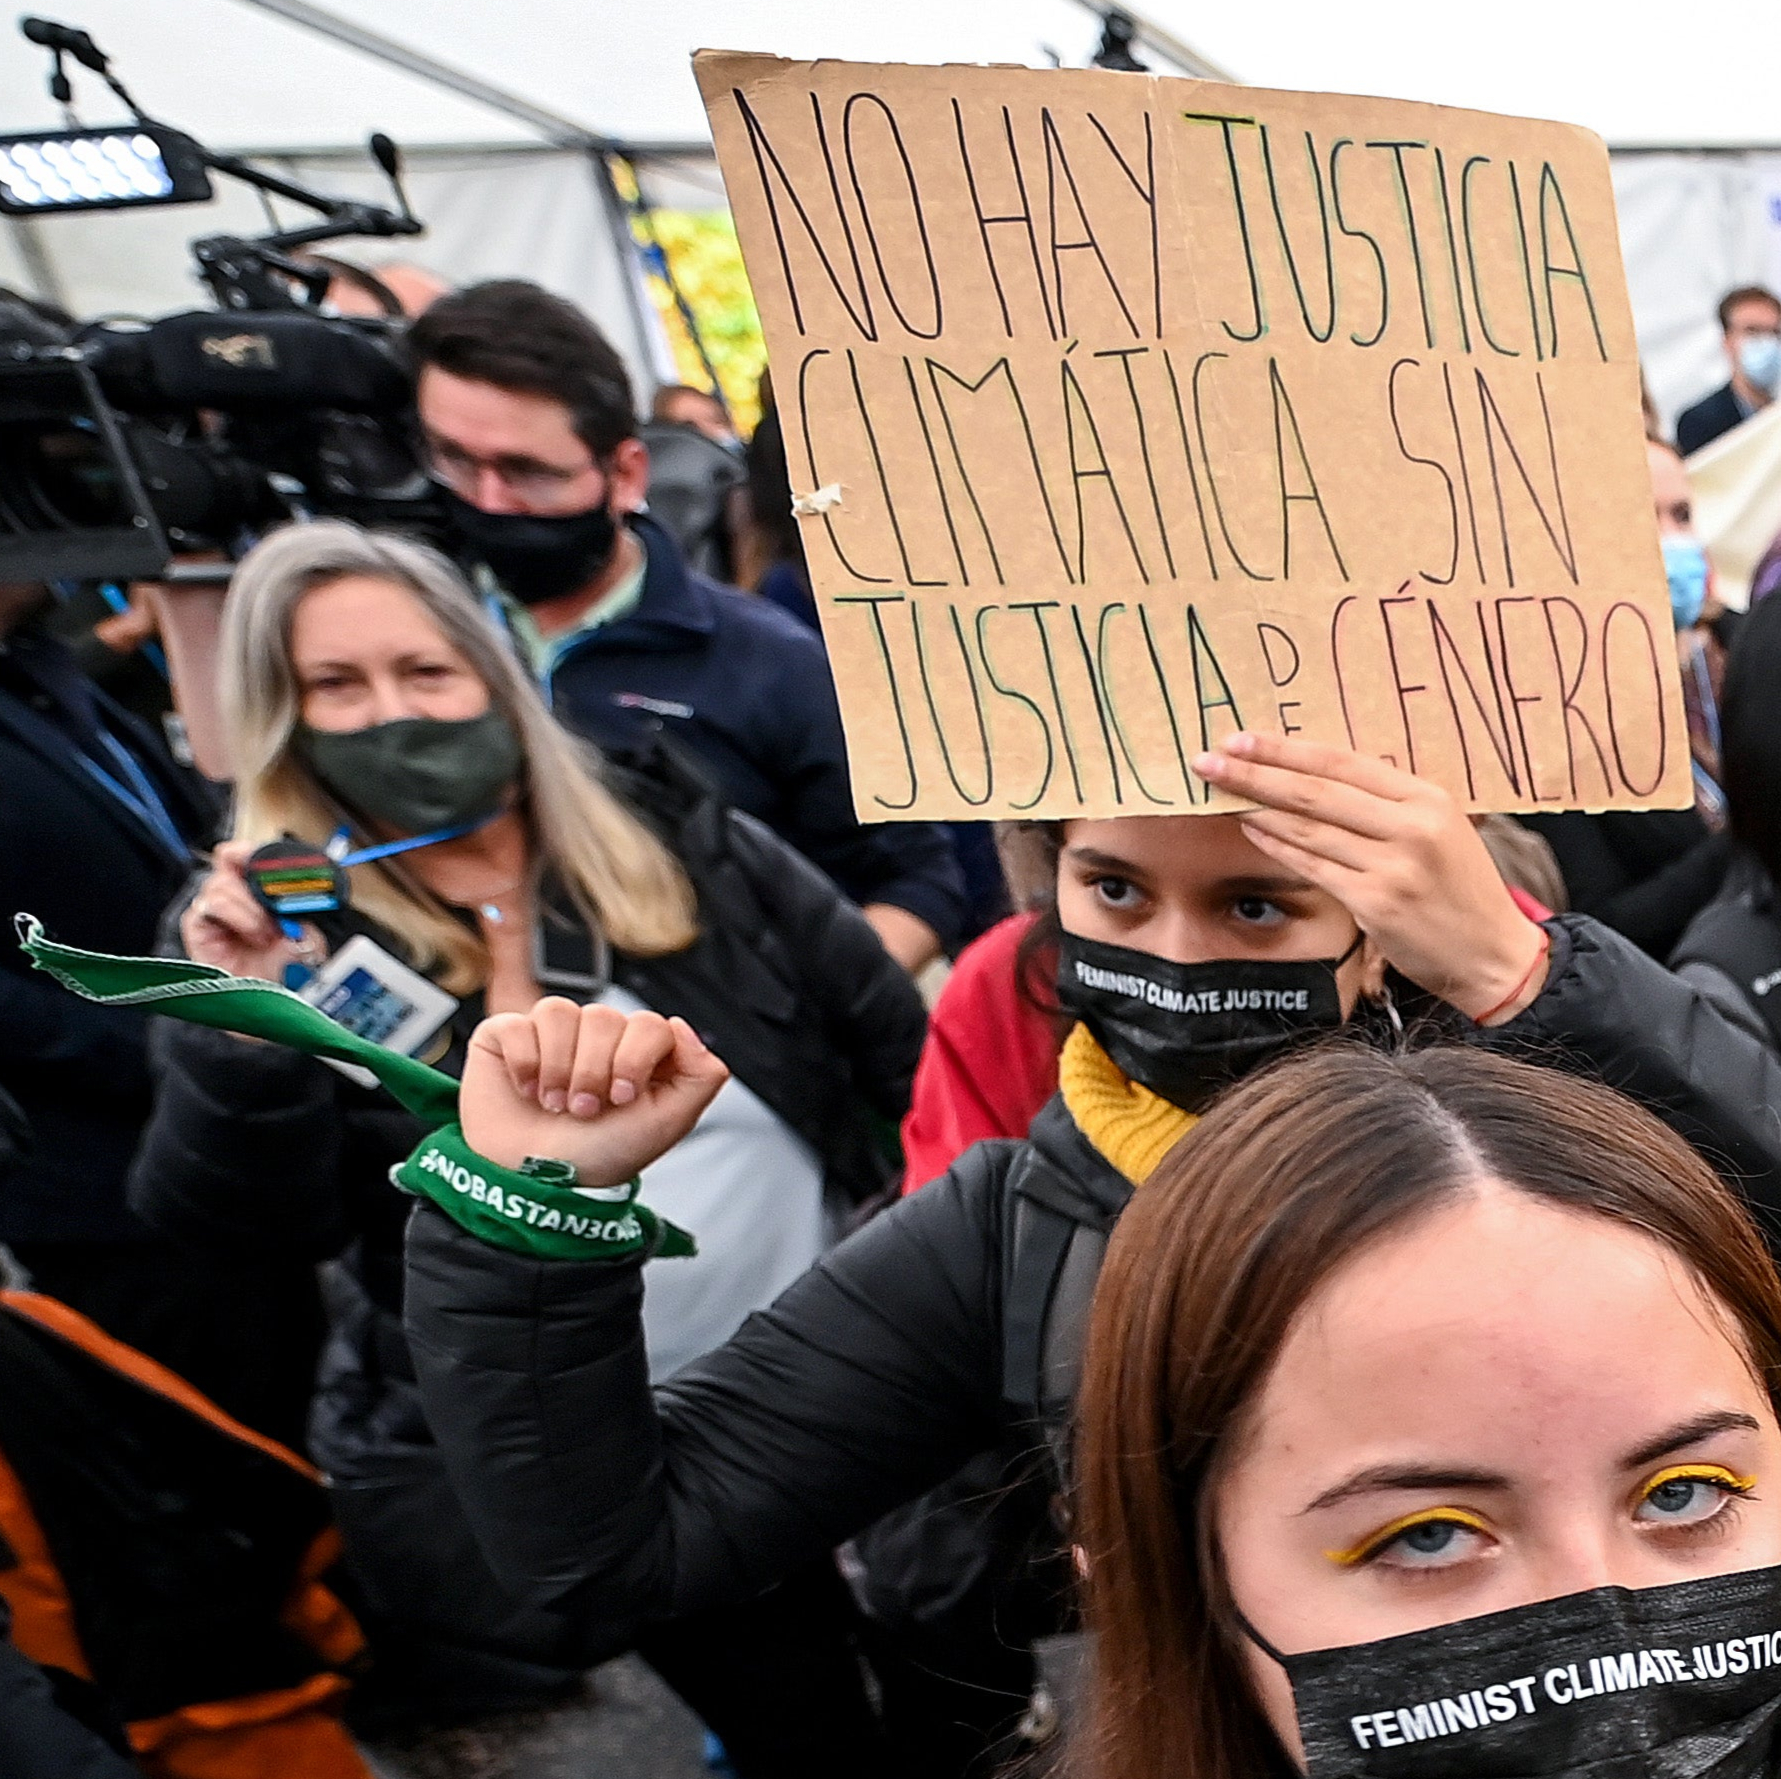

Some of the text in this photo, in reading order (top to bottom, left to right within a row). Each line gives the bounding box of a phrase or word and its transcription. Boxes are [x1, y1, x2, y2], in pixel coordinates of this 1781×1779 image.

[731, 86, 1607, 362] NO HAY JUSTICIA
[797, 339, 1580, 588] CLIMÁTICA SIN
[833, 590, 1245, 809] JUSTICIA
[1257, 622, 1303, 737] DE
[1074, 960, 1309, 1013] FEMINIST CLIMATE JUSTICE
[1350, 1675, 1538, 1750] FEMINIST
[1543, 1647, 1689, 1707] CLIMATE
